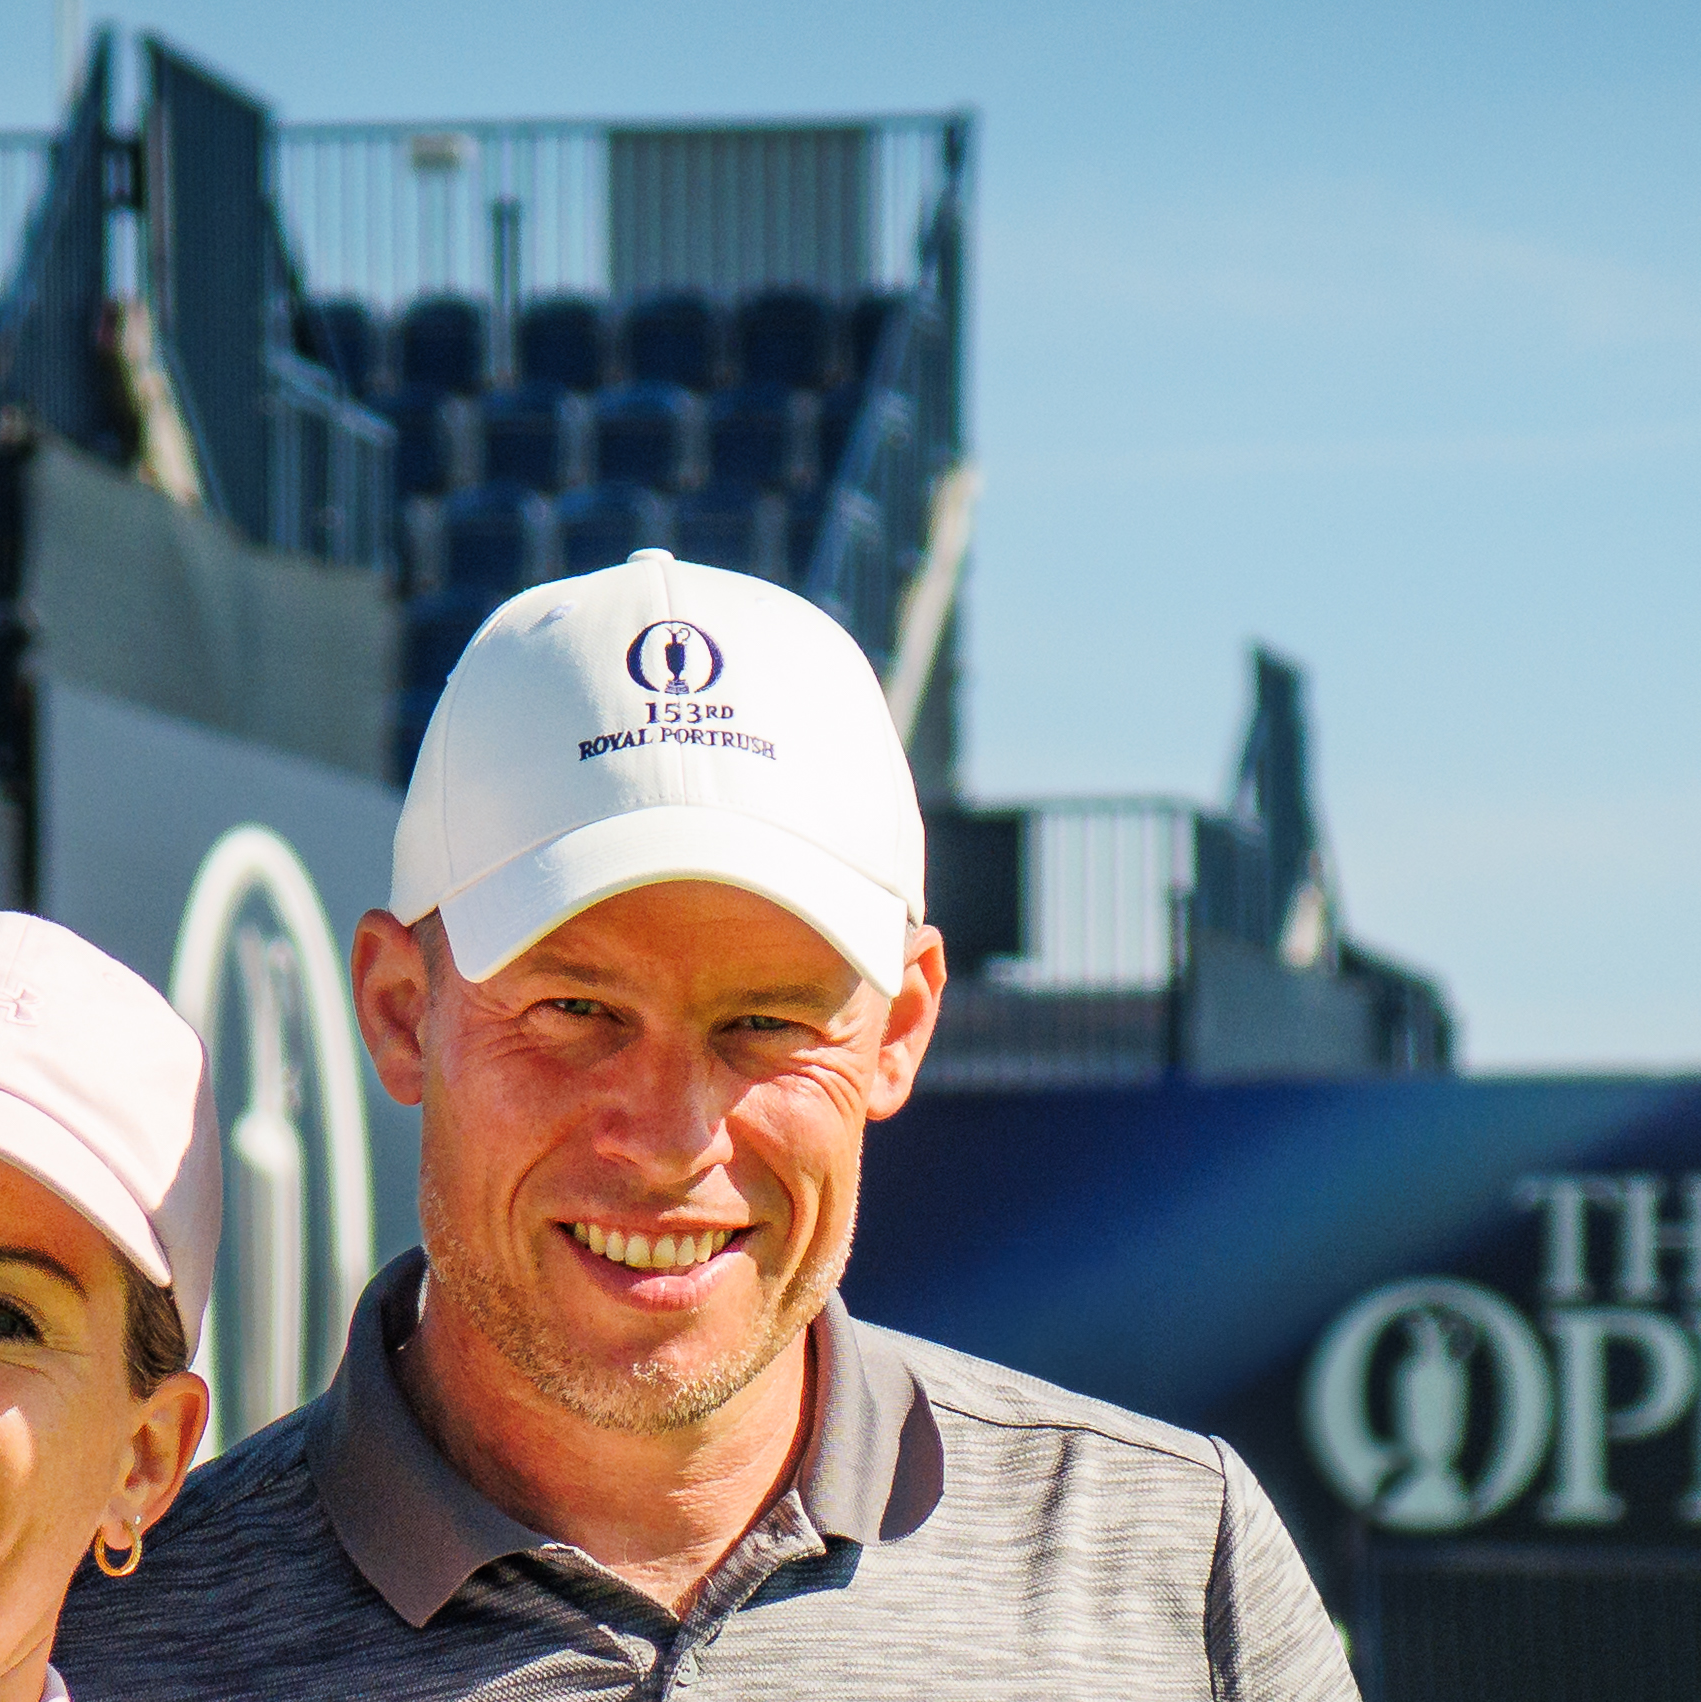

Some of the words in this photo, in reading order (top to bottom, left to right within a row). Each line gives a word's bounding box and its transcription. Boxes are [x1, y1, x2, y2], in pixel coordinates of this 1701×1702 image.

[645, 701, 735, 725] 153RD
[577, 727, 653, 762] ROYAL
[659, 726, 777, 761] PORTRUSH
